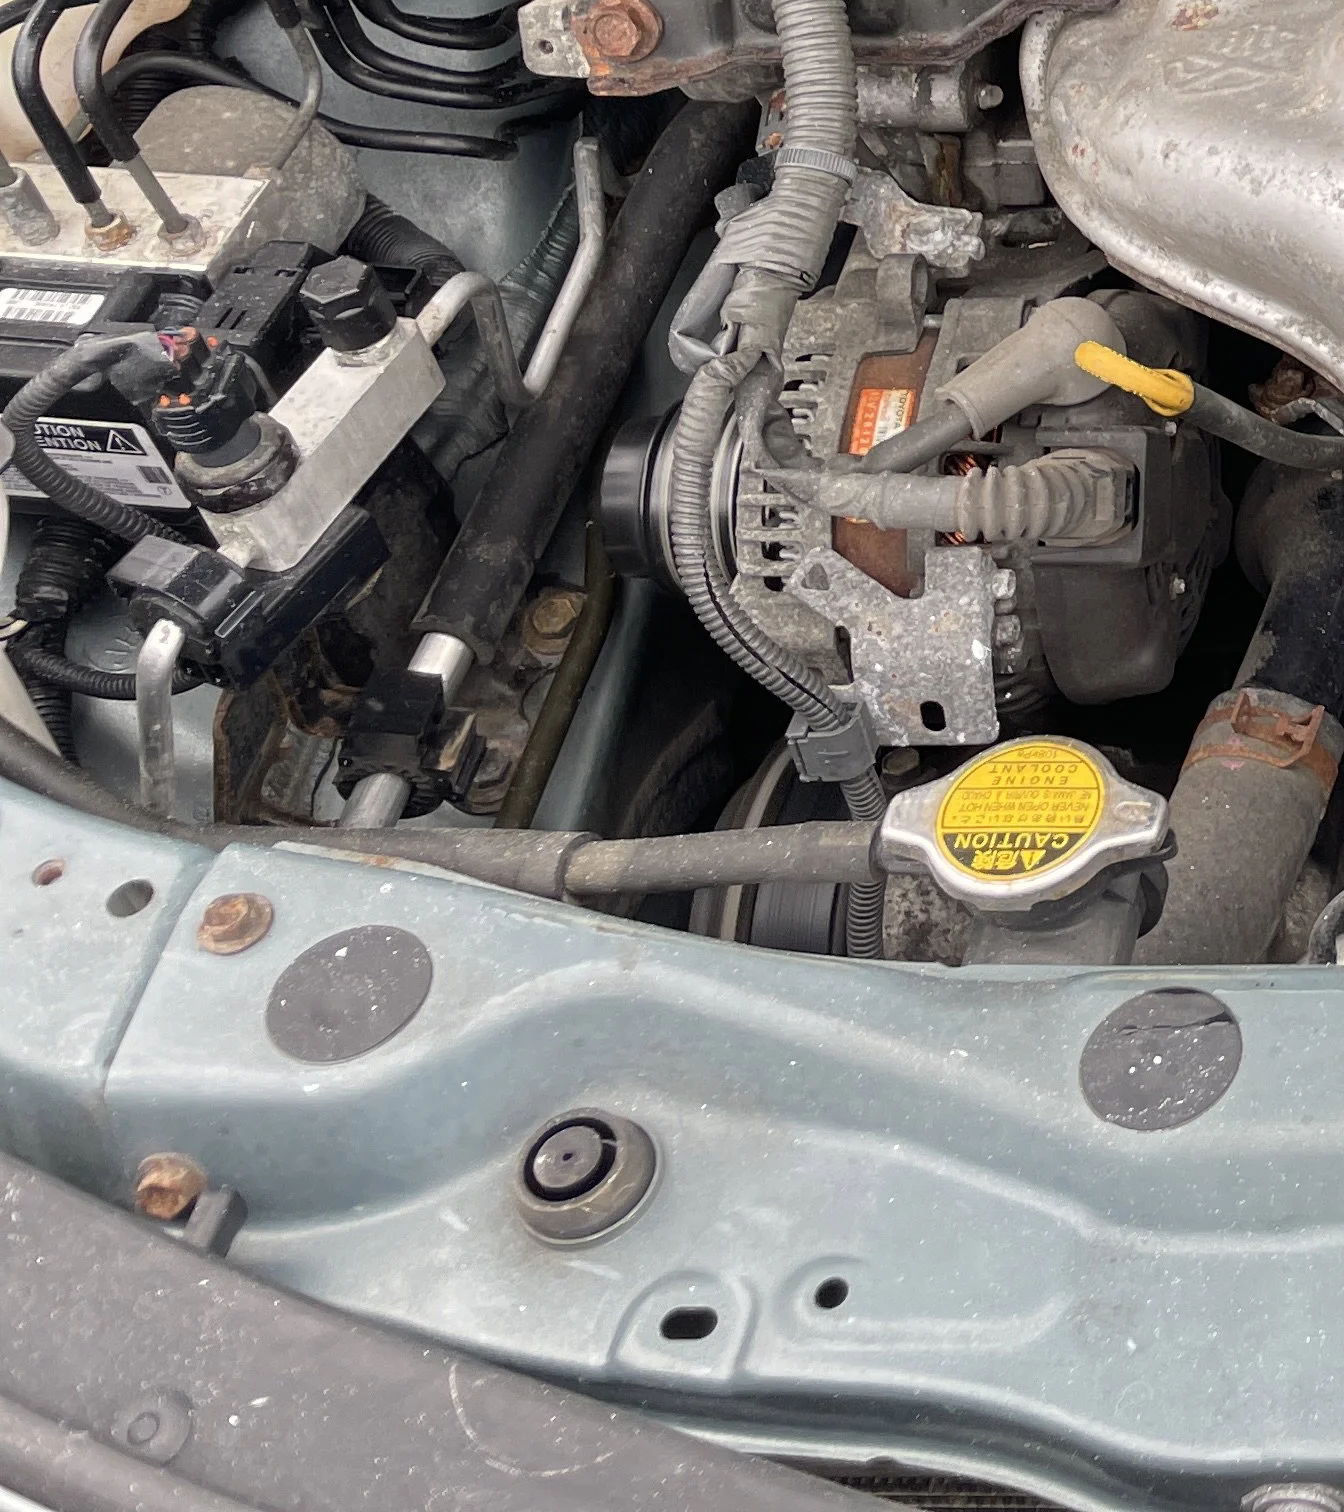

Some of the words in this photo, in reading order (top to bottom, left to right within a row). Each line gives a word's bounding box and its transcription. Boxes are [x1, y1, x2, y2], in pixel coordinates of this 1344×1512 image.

[988, 764, 1078, 774] COOLANT
[991, 775, 1069, 786] ENGINE
[959, 802, 983, 812] HOT
[983, 802, 1016, 812] WHEN
[1018, 802, 1049, 812] OPEN
[1052, 802, 1091, 812] NEVER
[954, 833, 1069, 848] CAUTION
